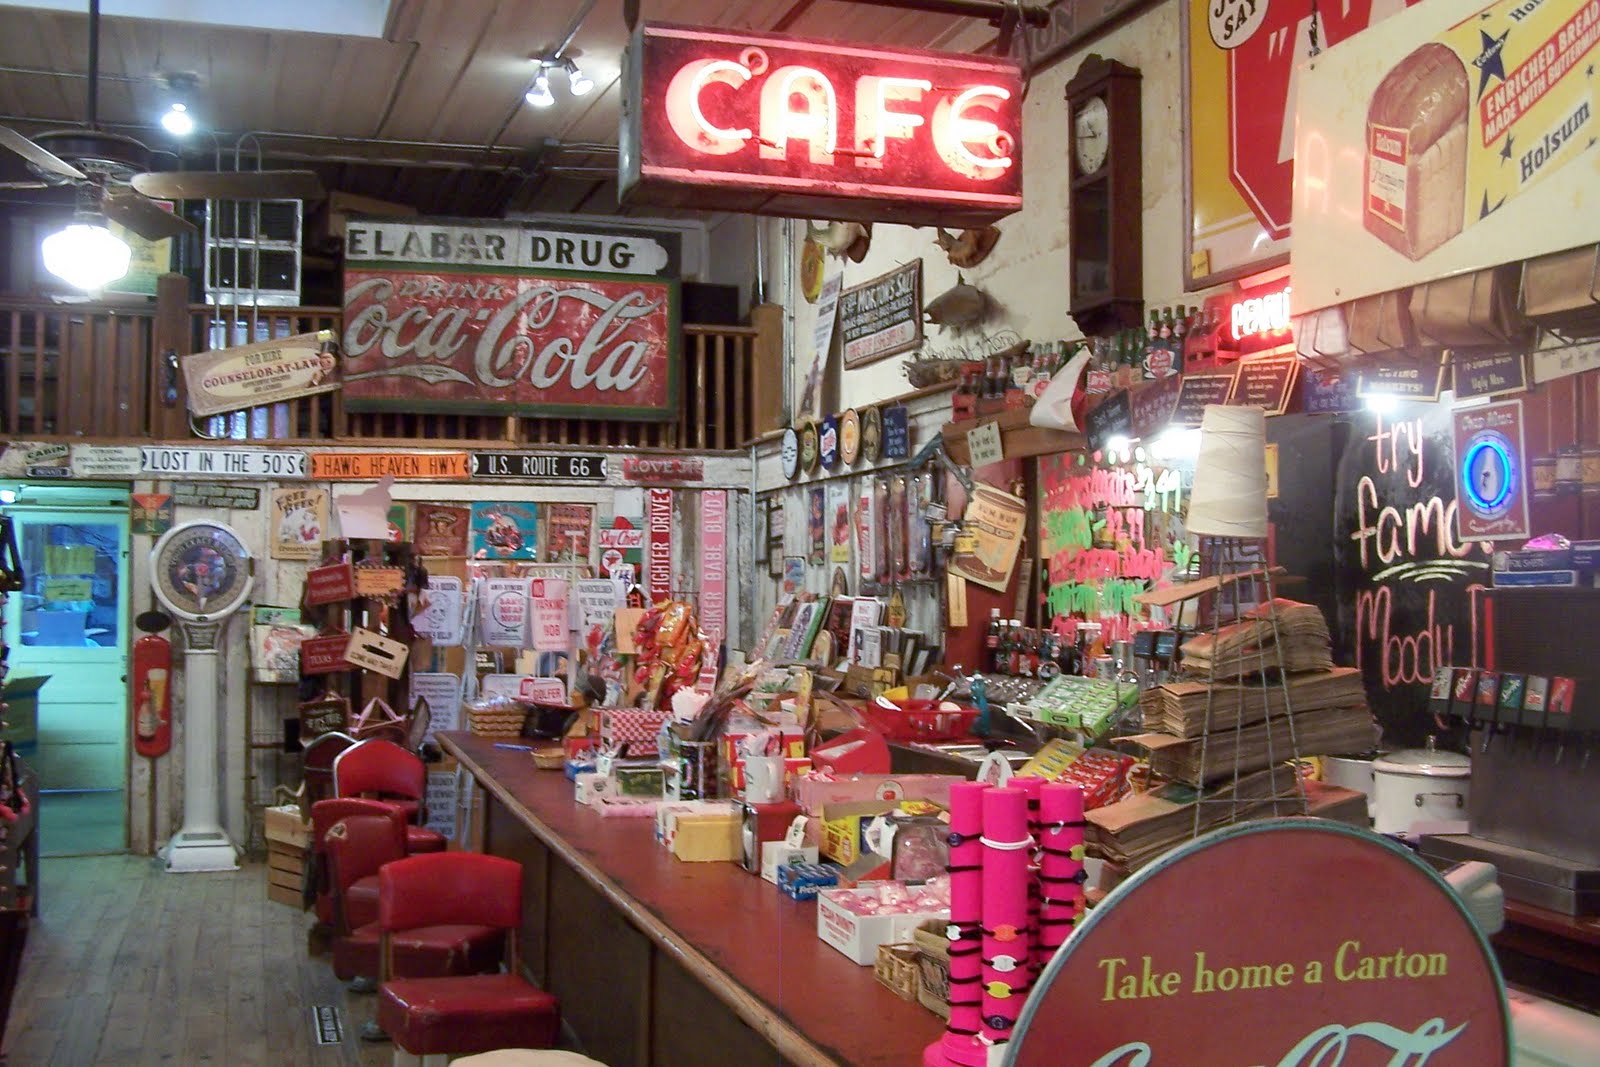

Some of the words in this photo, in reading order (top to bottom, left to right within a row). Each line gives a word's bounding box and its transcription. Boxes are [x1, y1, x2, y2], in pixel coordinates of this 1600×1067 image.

[1223, 0, 1257, 41] SAY
[1486, 42, 1556, 121] ENRICHED
[1558, 0, 1600, 56] BREAD
[664, 56, 1013, 182] CAFE
[1485, 99, 1519, 144] MADE
[1517, 72, 1547, 112] WITH
[1520, 101, 1590, 184] Holsum
[348, 228, 507, 261] ELABAR
[531, 235, 635, 270] DRUG
[399, 278, 504, 301] DRINK
[342, 276, 664, 391] Coca-Cola
[27, 445, 67, 460] CABIN
[151, 450, 190, 471] LOST
[199, 452, 214, 473] IN
[222, 453, 251, 474] THE
[261, 454, 297, 475] 50'S
[323, 455, 361, 477] HAWG
[370, 455, 425, 477] HEAVEN
[429, 454, 458, 476] HWY
[488, 455, 512, 474] U.S.
[522, 455, 560, 476] ROUTE
[569, 456, 591, 477] 66
[1367, 404, 1424, 489] try
[629, 460, 674, 475] LOVE
[651, 495, 671, 534] DRIVE
[704, 498, 722, 534] BLVD
[1350, 475, 1495, 569] famo
[651, 541, 671, 594] FIGHTER
[704, 543, 722, 582] BABE
[704, 589, 722, 631] BIKER
[532, 687, 561, 700] GOLFER
[1099, 954, 1182, 1002] Take
[1192, 950, 1296, 994] home
[1303, 960, 1324, 985] a
[1332, 940, 1449, 982] Carton
